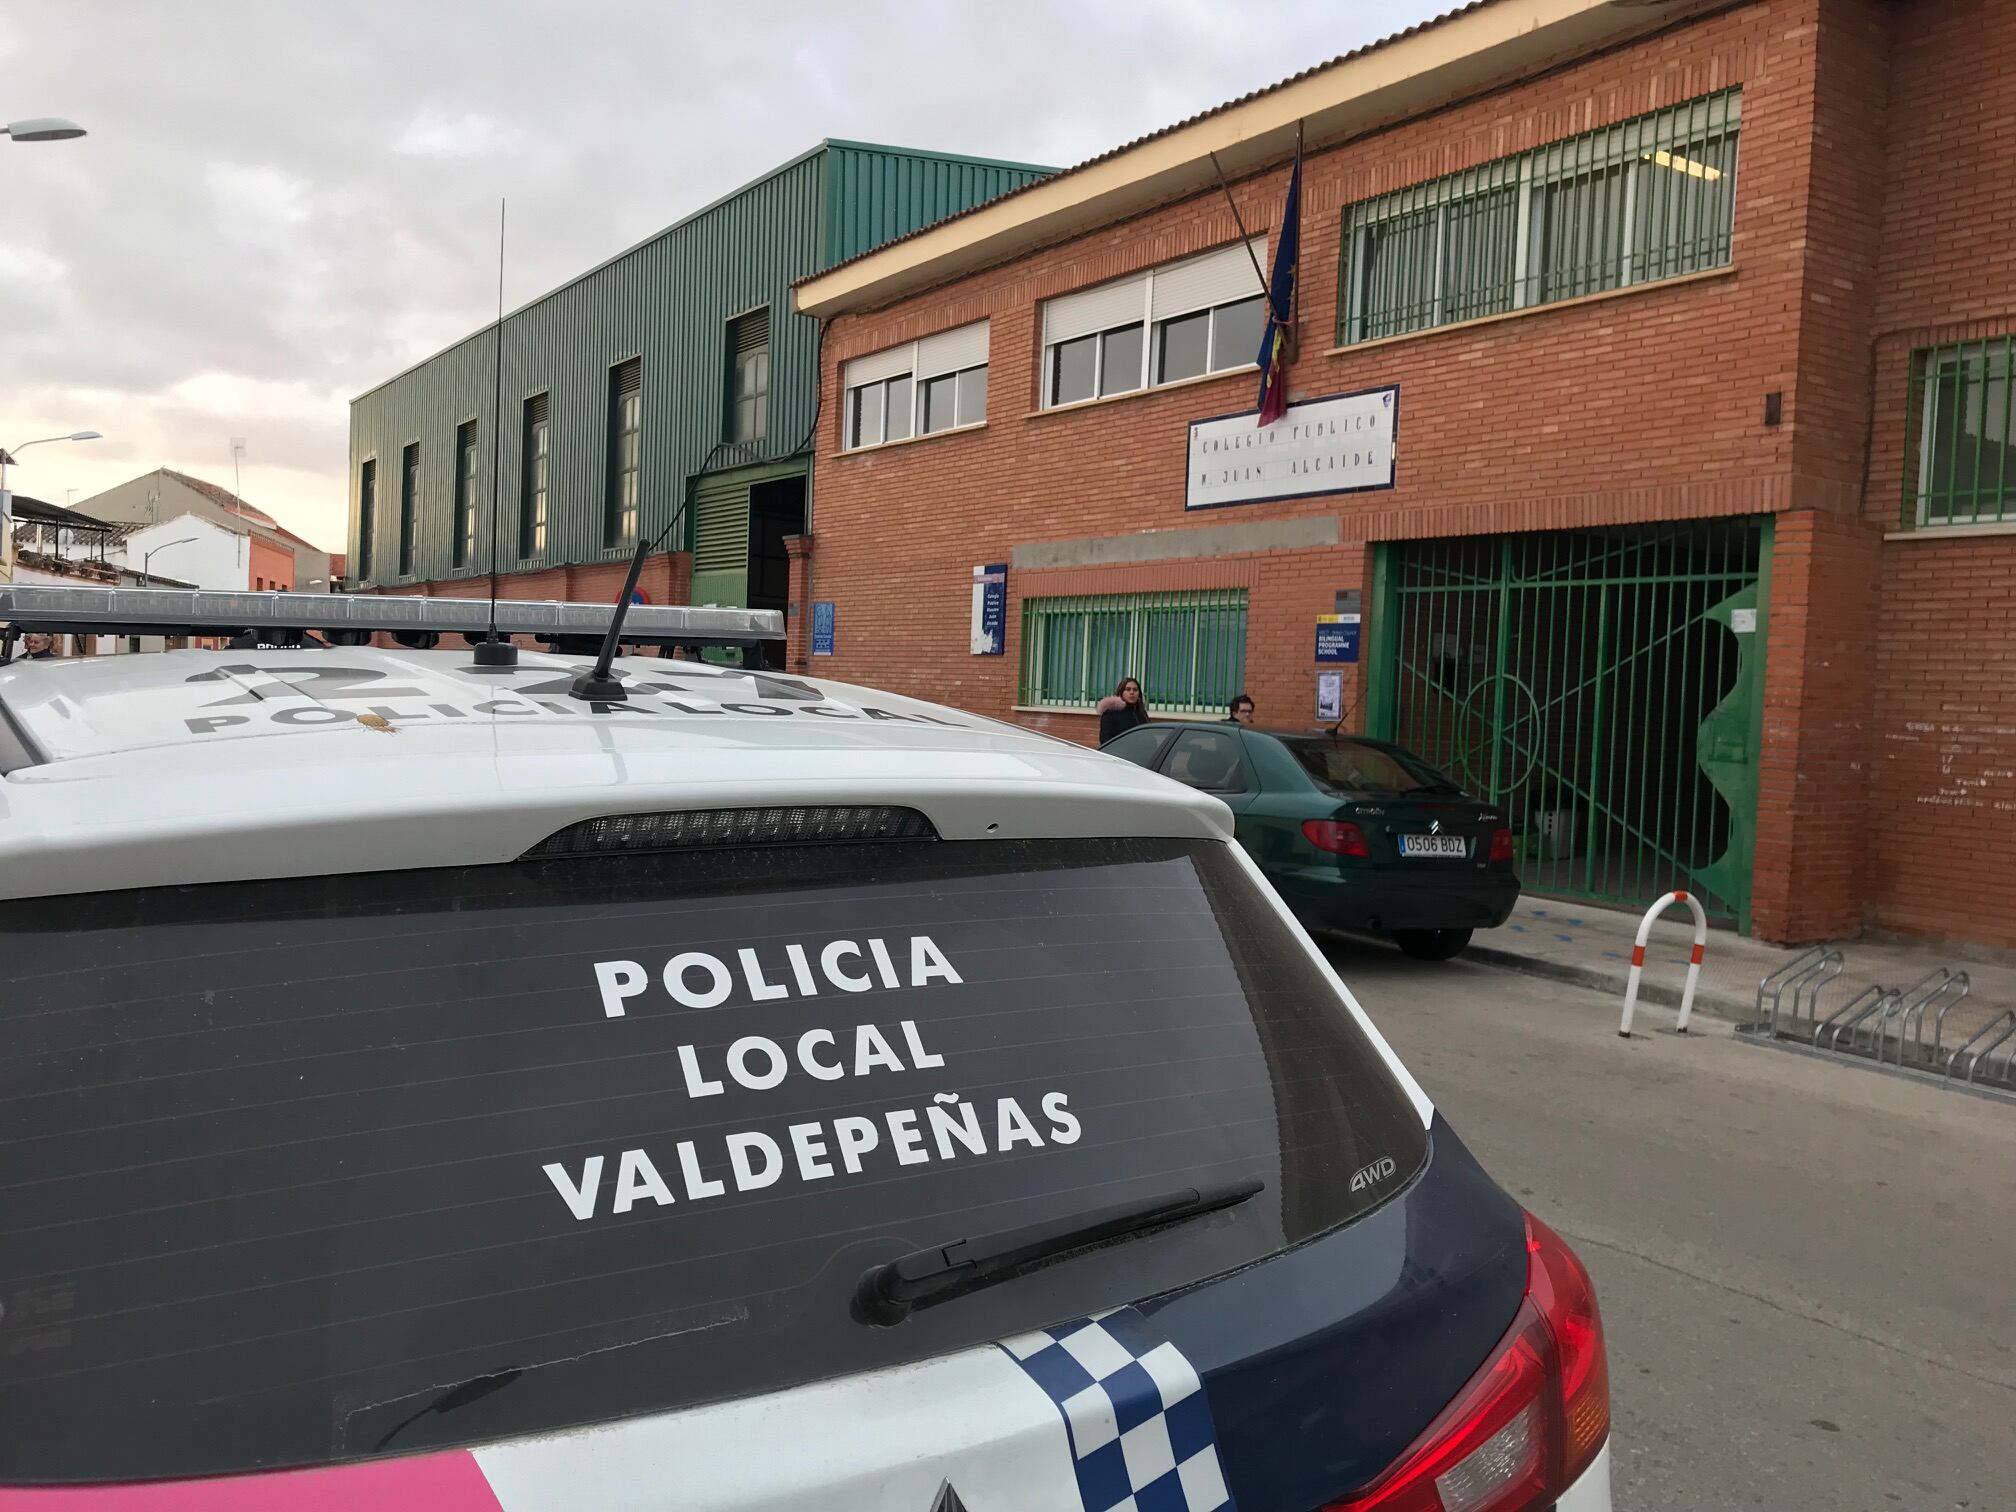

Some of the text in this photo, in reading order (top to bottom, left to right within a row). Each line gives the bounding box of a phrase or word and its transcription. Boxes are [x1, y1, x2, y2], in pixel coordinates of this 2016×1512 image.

[1203, 431, 1275, 454] COLEGIO
[1222, 467, 1262, 484] JUAN
[1291, 451, 1373, 475] ALCAIDE
[183, 699, 973, 735] POLICIA LOCAL
[1407, 836, 1438, 852] 0506
[1440, 837, 1464, 853] BDZ
[594, 935, 964, 1019] POLICIA
[677, 1020, 945, 1099] LOCAL
[542, 1091, 1082, 1221] VALDEPEÑAS
[1351, 1158, 1395, 1192] 4WD
